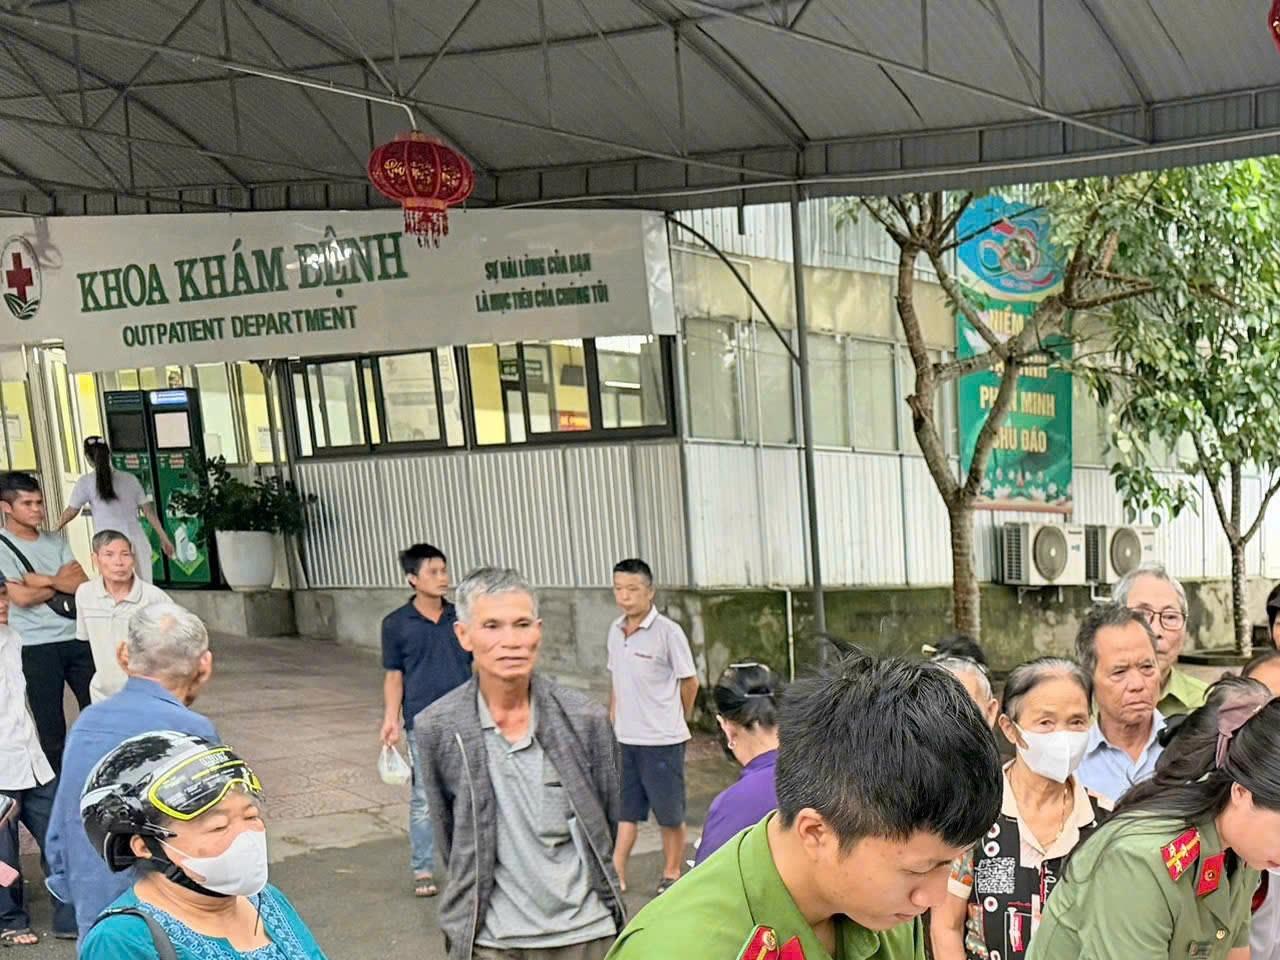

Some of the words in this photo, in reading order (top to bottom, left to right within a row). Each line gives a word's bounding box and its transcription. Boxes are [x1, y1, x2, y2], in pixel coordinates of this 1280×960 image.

[77, 263, 169, 312] KHOA
[174, 238, 288, 302] KHÁM
[294, 225, 408, 298] BỆNH
[485, 259, 498, 284] SỰ
[547, 249, 568, 275] CỦA
[569, 253, 591, 277] BẠN
[476, 290, 490, 312] LÀ
[535, 282, 556, 308] CỦA
[591, 280, 609, 303] TÔI
[122, 316, 225, 347] OUTPATIENT
[231, 305, 358, 338] DEPARTMENT
[1021, 391, 1055, 417] MINH
